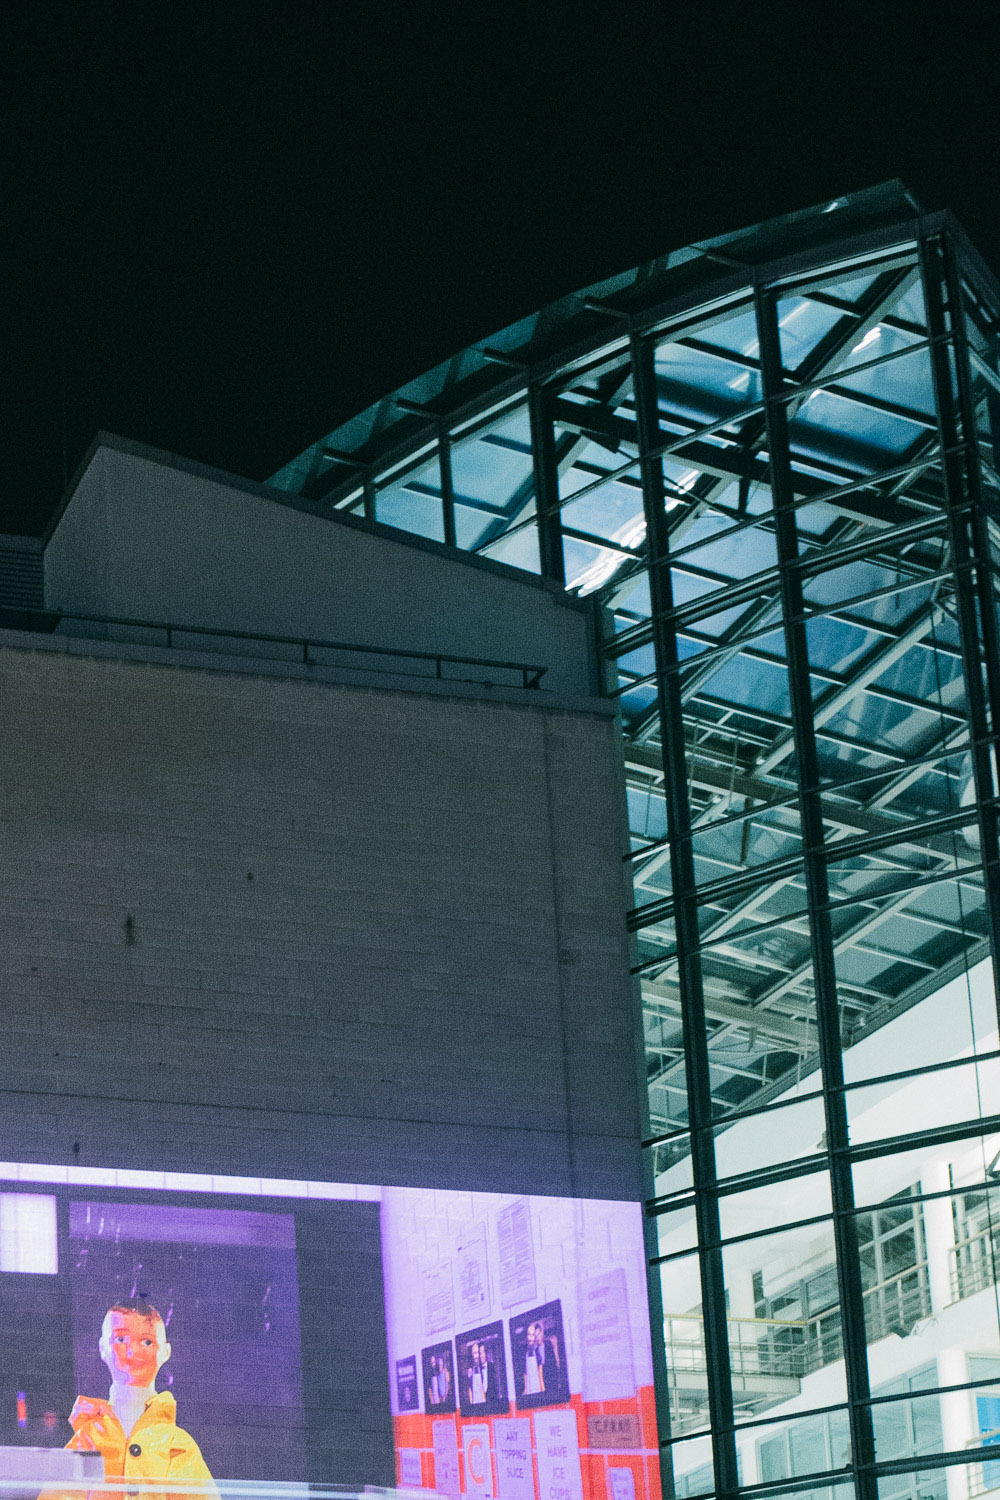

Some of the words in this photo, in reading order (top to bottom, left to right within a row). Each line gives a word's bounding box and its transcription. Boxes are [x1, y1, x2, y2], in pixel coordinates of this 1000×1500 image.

[506, 1431, 518, 1442] ANY
[549, 1425, 562, 1438] WE
[501, 1449, 527, 1460] TOPPING
[547, 1446, 568, 1458] HAVE
